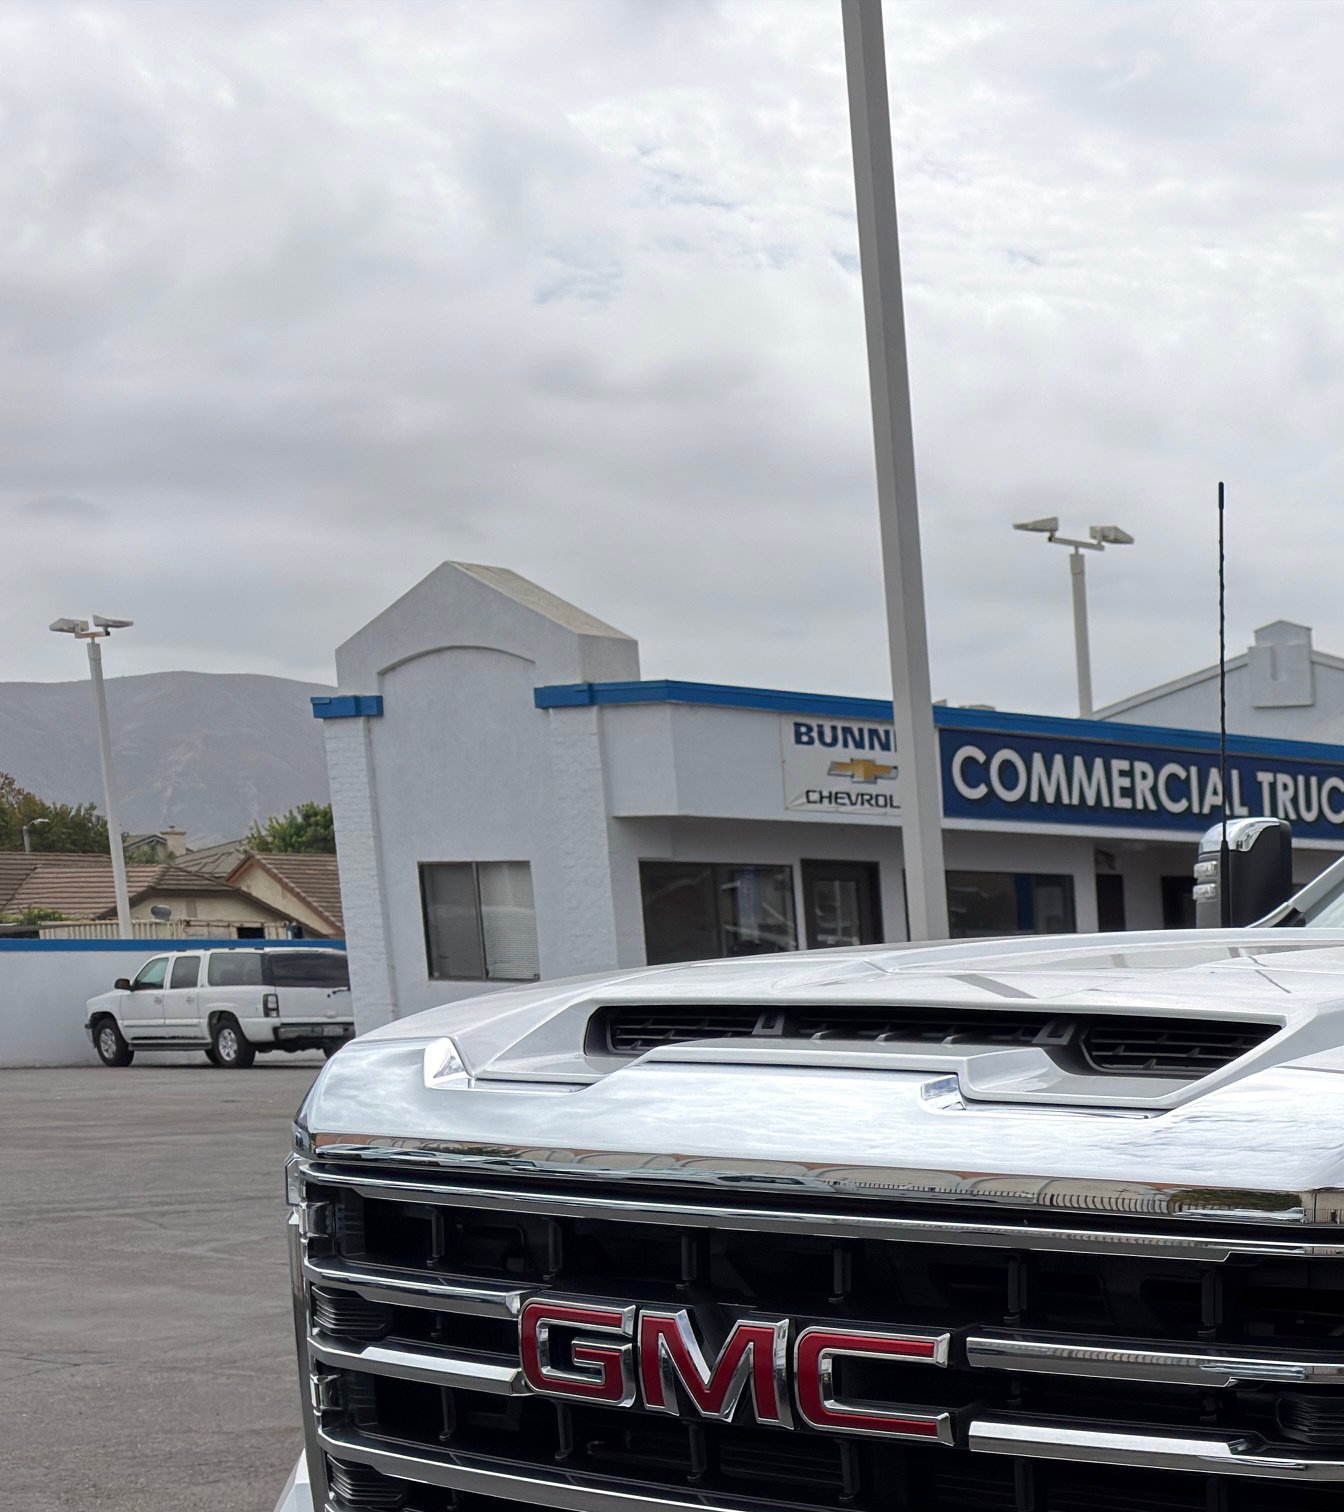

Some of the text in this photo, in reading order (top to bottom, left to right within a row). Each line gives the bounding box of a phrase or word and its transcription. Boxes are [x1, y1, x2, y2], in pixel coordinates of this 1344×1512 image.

[793, 722, 897, 753] BUNN
[952, 745, 1249, 817] COMMERCIAL
[519, 1297, 955, 1446] GMC
